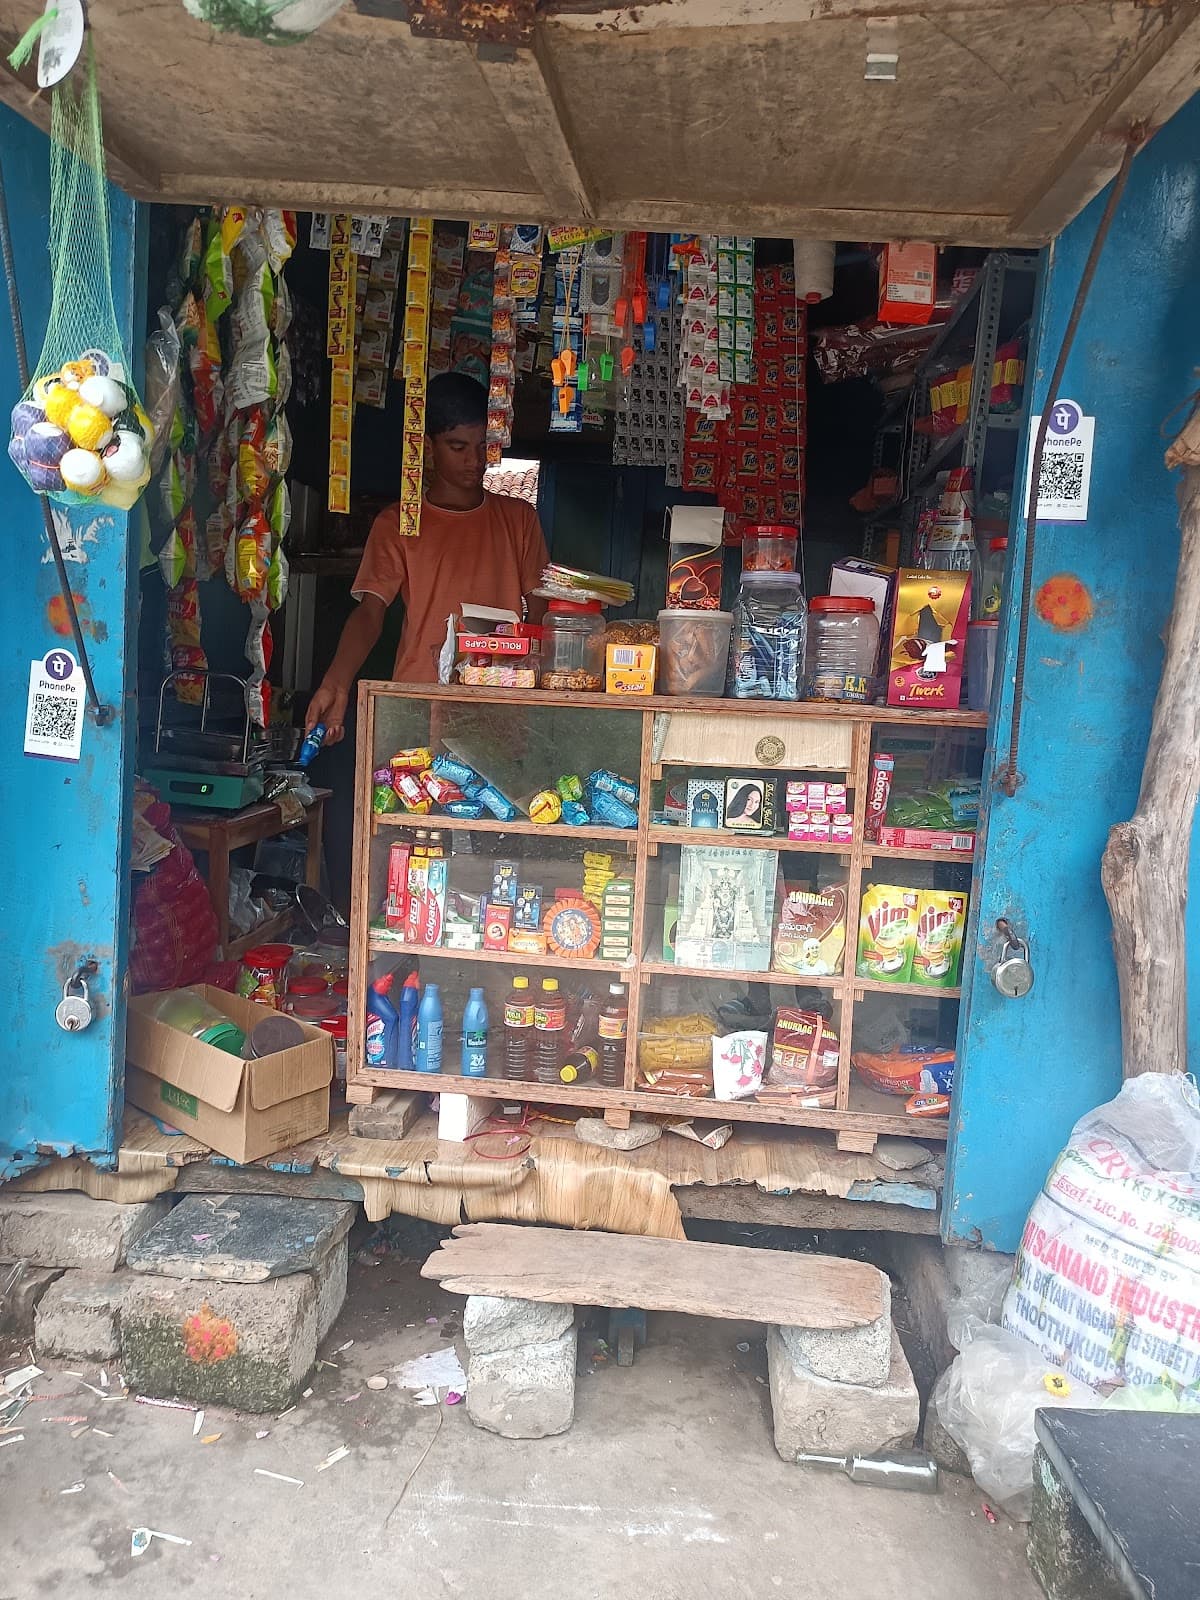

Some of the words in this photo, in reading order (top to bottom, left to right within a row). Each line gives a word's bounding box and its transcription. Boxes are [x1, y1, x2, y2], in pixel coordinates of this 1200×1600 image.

[697, 419, 716, 431] Tide
[1045, 437, 1082, 447] honePe
[694, 464, 712, 476] Tide
[465, 640, 487, 648] CAPS
[501, 642, 522, 650] ROLL
[39, 680, 76, 693] PhonePe
[909, 683, 945, 697] Twerk
[869, 770, 888, 811] closeup
[789, 891, 835, 907] ANURAAG
[409, 897, 418, 924] RED
[425, 899, 438, 943] Colgate
[868, 901, 909, 941] Vim
[777, 1019, 813, 1035] ANURAAG
[1142, 1333, 1193, 1375] STREET
